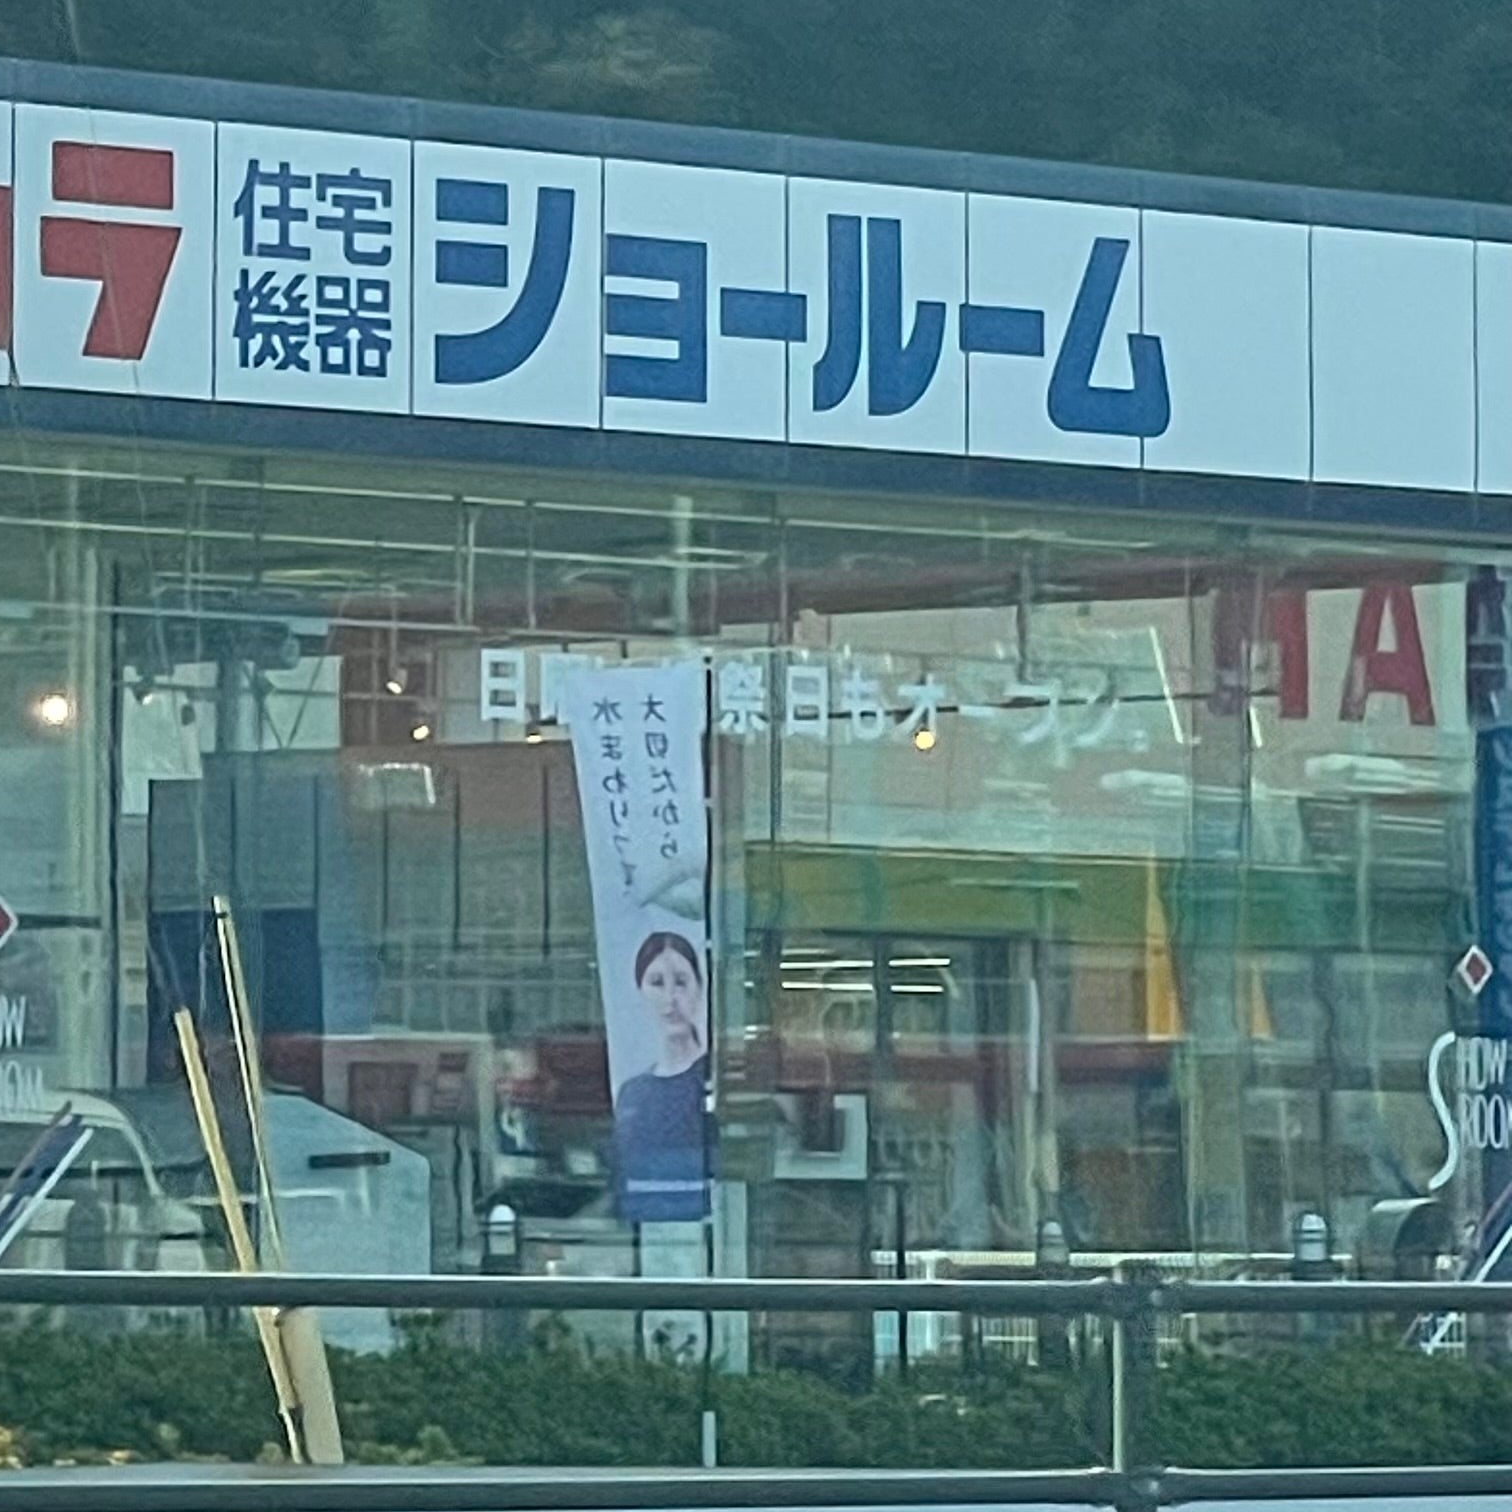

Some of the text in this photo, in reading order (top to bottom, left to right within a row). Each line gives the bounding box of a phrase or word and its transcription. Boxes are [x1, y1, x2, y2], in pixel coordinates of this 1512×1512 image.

[233, 158, 392, 267] 住宅
[234, 268, 392, 377] 機器
[434, 178, 1171, 439] ショールーム
[1458, 1092, 1511, 1150] ROO
